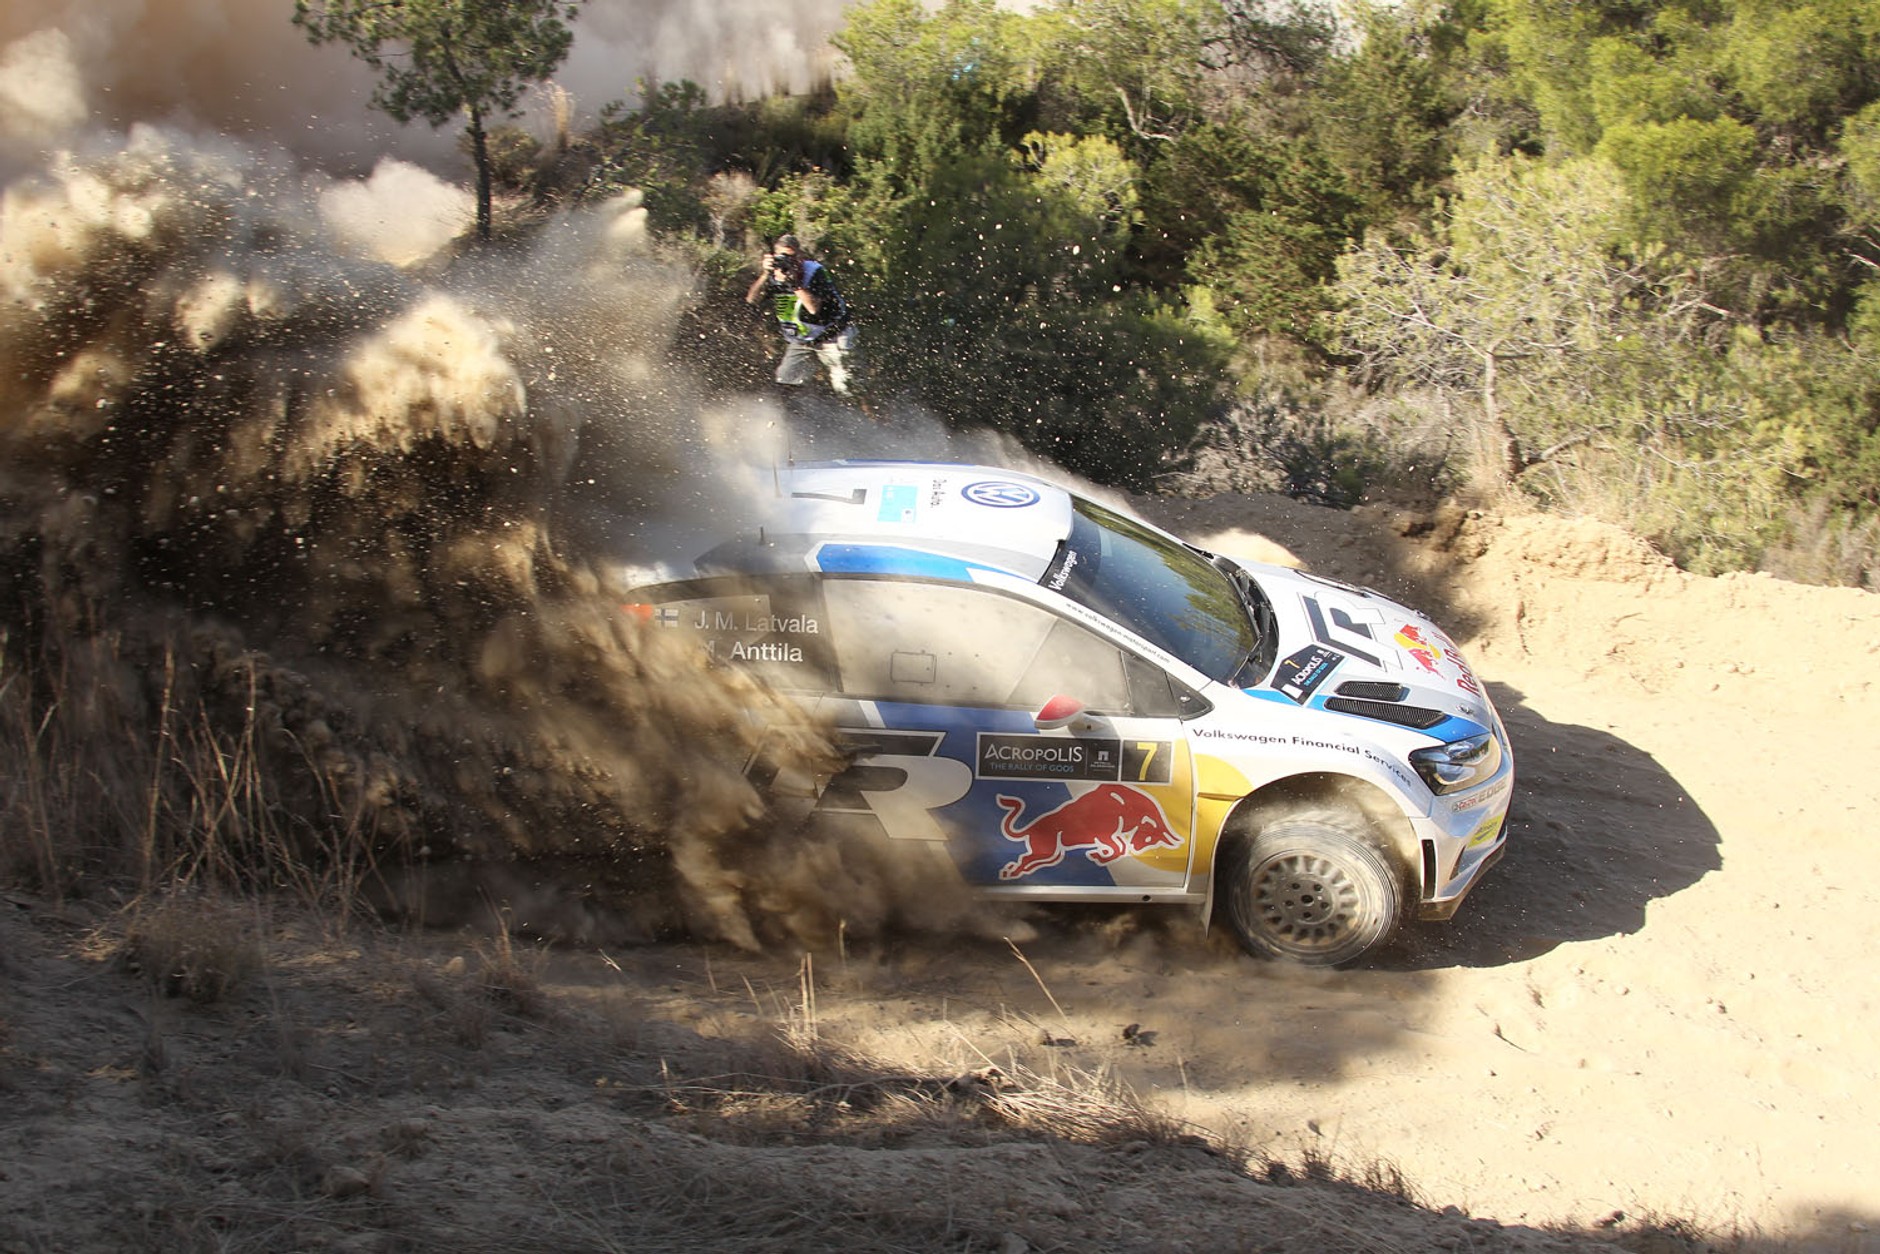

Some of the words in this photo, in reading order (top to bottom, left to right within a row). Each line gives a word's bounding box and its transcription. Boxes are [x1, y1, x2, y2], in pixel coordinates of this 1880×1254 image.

[1048, 550, 1078, 591] Volkswagen
[694, 610, 709, 629] J.
[715, 611, 738, 631] M.
[745, 613, 819, 634] Latvala
[731, 641, 803, 662] Anttila
[1284, 659, 1300, 669] 7
[984, 743, 1083, 762] ACROPOLIS
[1136, 742, 1158, 781] 7
[1192, 728, 1287, 745] Volkswagen
[1292, 735, 1360, 755] Financial
[1364, 749, 1412, 788] Services
[991, 761, 1007, 770] THE
[1035, 763, 1048, 772] OF
